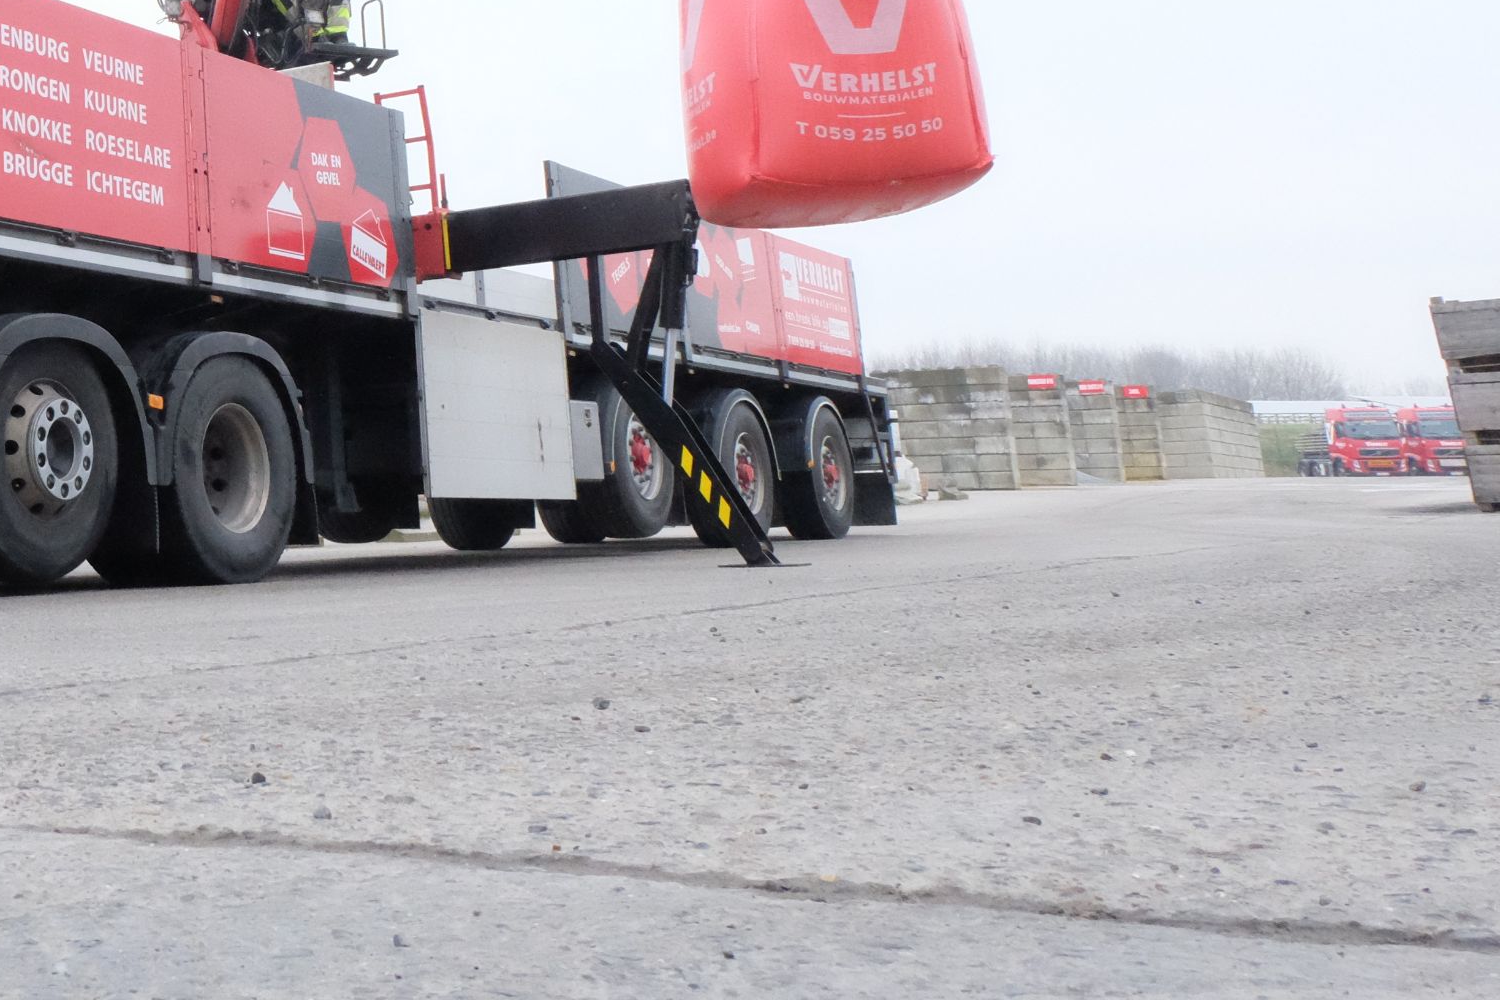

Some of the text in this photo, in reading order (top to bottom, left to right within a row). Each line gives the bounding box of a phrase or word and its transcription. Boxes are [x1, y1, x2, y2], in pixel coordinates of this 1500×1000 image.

[82, 48, 144, 85] VEURNE
[788, 62, 937, 93] VERHELST
[84, 89, 147, 125] KUURNE
[803, 87, 934, 105] BOUWMATERIALEN
[2, 108, 172, 169] KNOKKE ROESELARE
[796, 117, 943, 142] T 059 25 50 50
[311, 152, 342, 168] DAK EN
[3, 151, 164, 206] BRUGGE ICHTEGEM
[316, 171, 341, 186] GEVEL
[352, 245, 386, 274] CALLEWAERT
[796, 257, 844, 294] VERHELST
